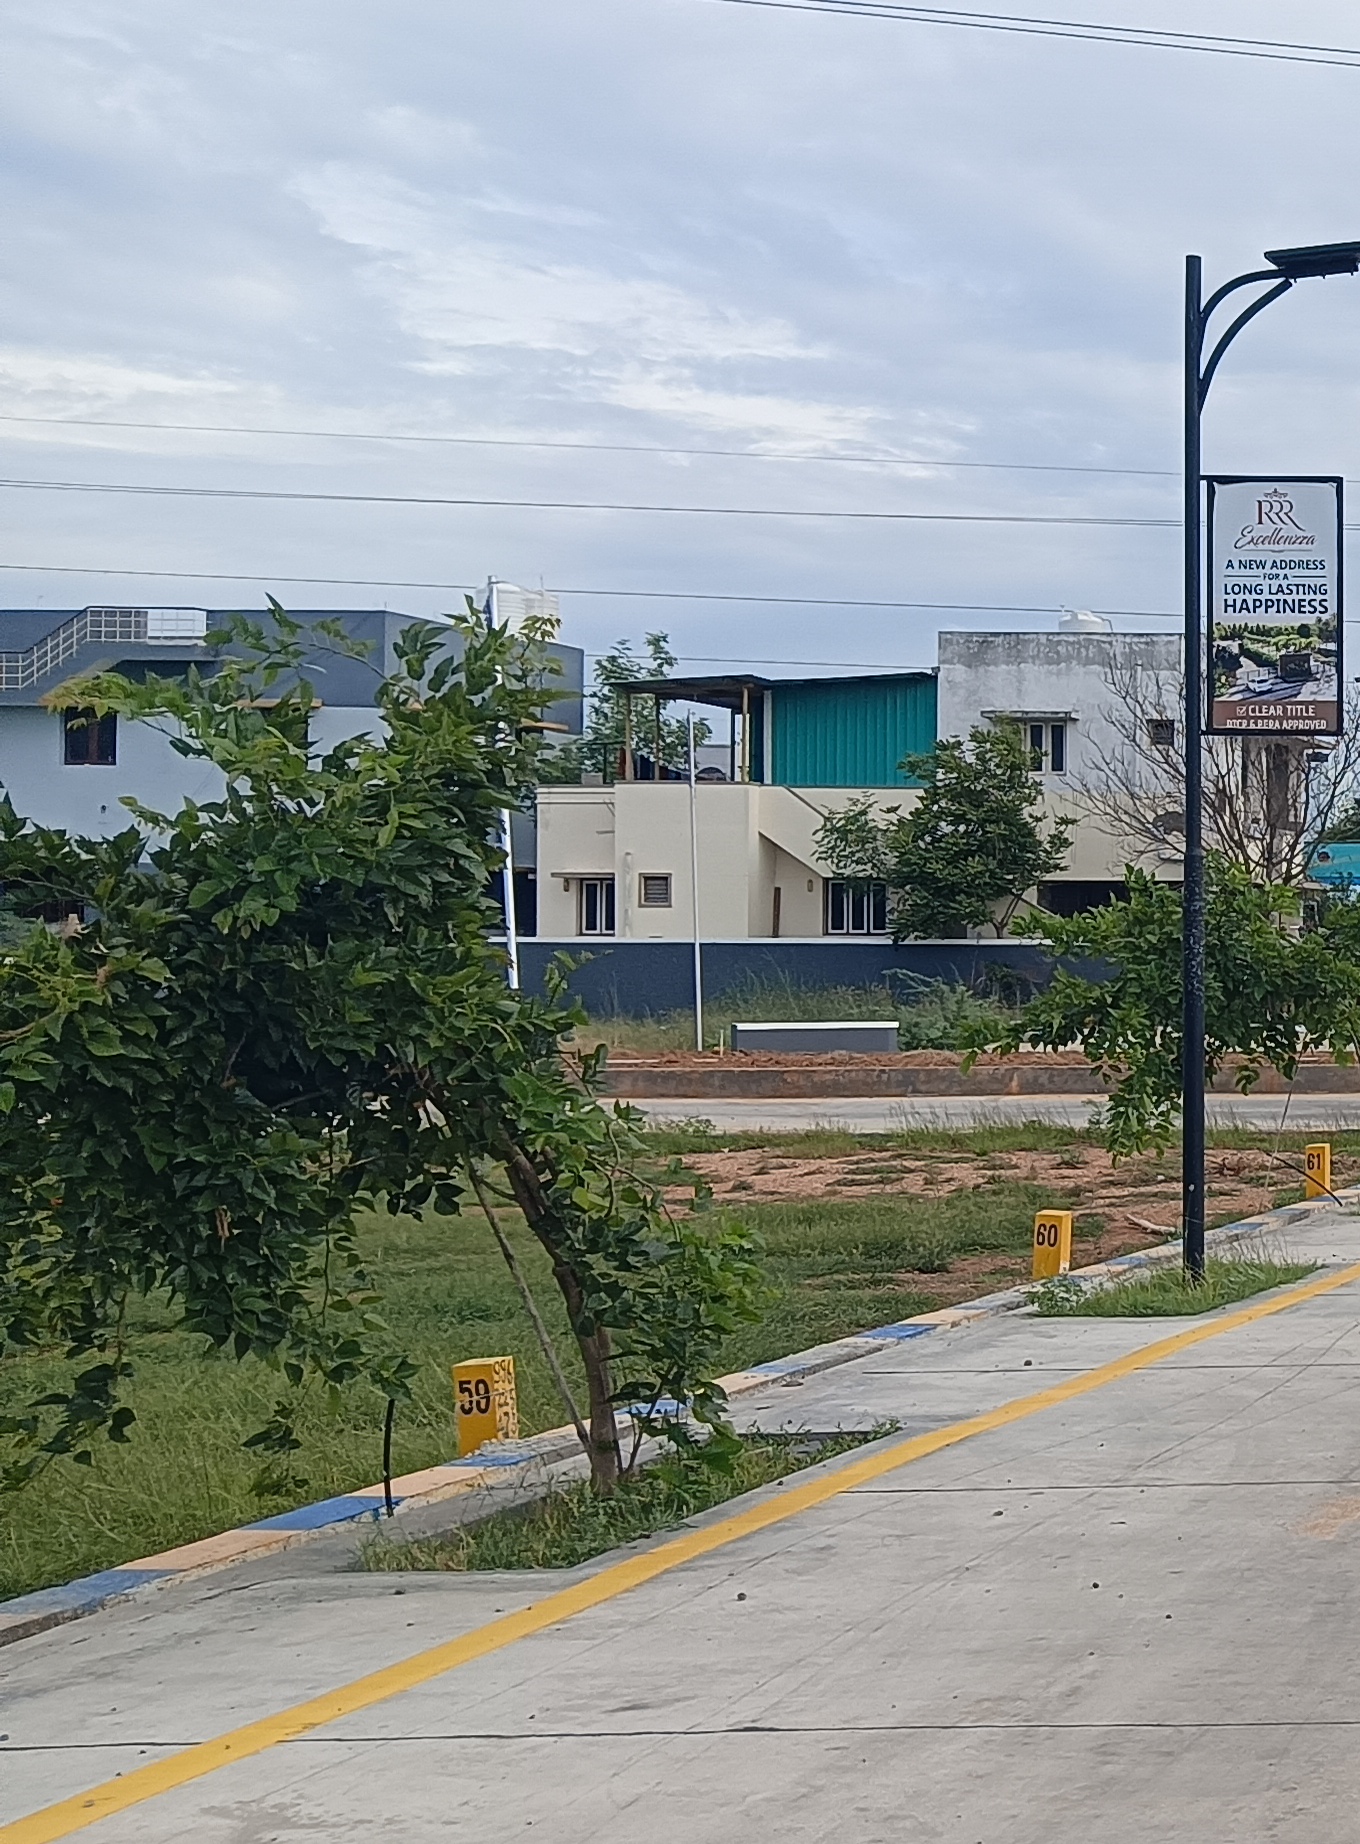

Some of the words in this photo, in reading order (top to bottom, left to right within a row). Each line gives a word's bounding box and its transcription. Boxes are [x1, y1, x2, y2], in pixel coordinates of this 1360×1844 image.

[1225, 559, 1235, 570] A
[1238, 559, 1267, 570] NEW
[1270, 559, 1326, 570] ADDRESS
[1263, 573, 1280, 581] FOR
[1282, 573, 1289, 581] A
[1224, 583, 1264, 596] LONG
[1268, 583, 1328, 596] LASTING
[1223, 598, 1329, 615] HAPPINESS
[1248, 705, 1283, 716] CLEAR
[1286, 705, 1316, 716] TITLE
[1282, 720, 1327, 730] APPROVED
[1307, 1153, 1321, 1170] 61
[1036, 1223, 1058, 1248] 60
[458, 1378, 491, 1415] 59
